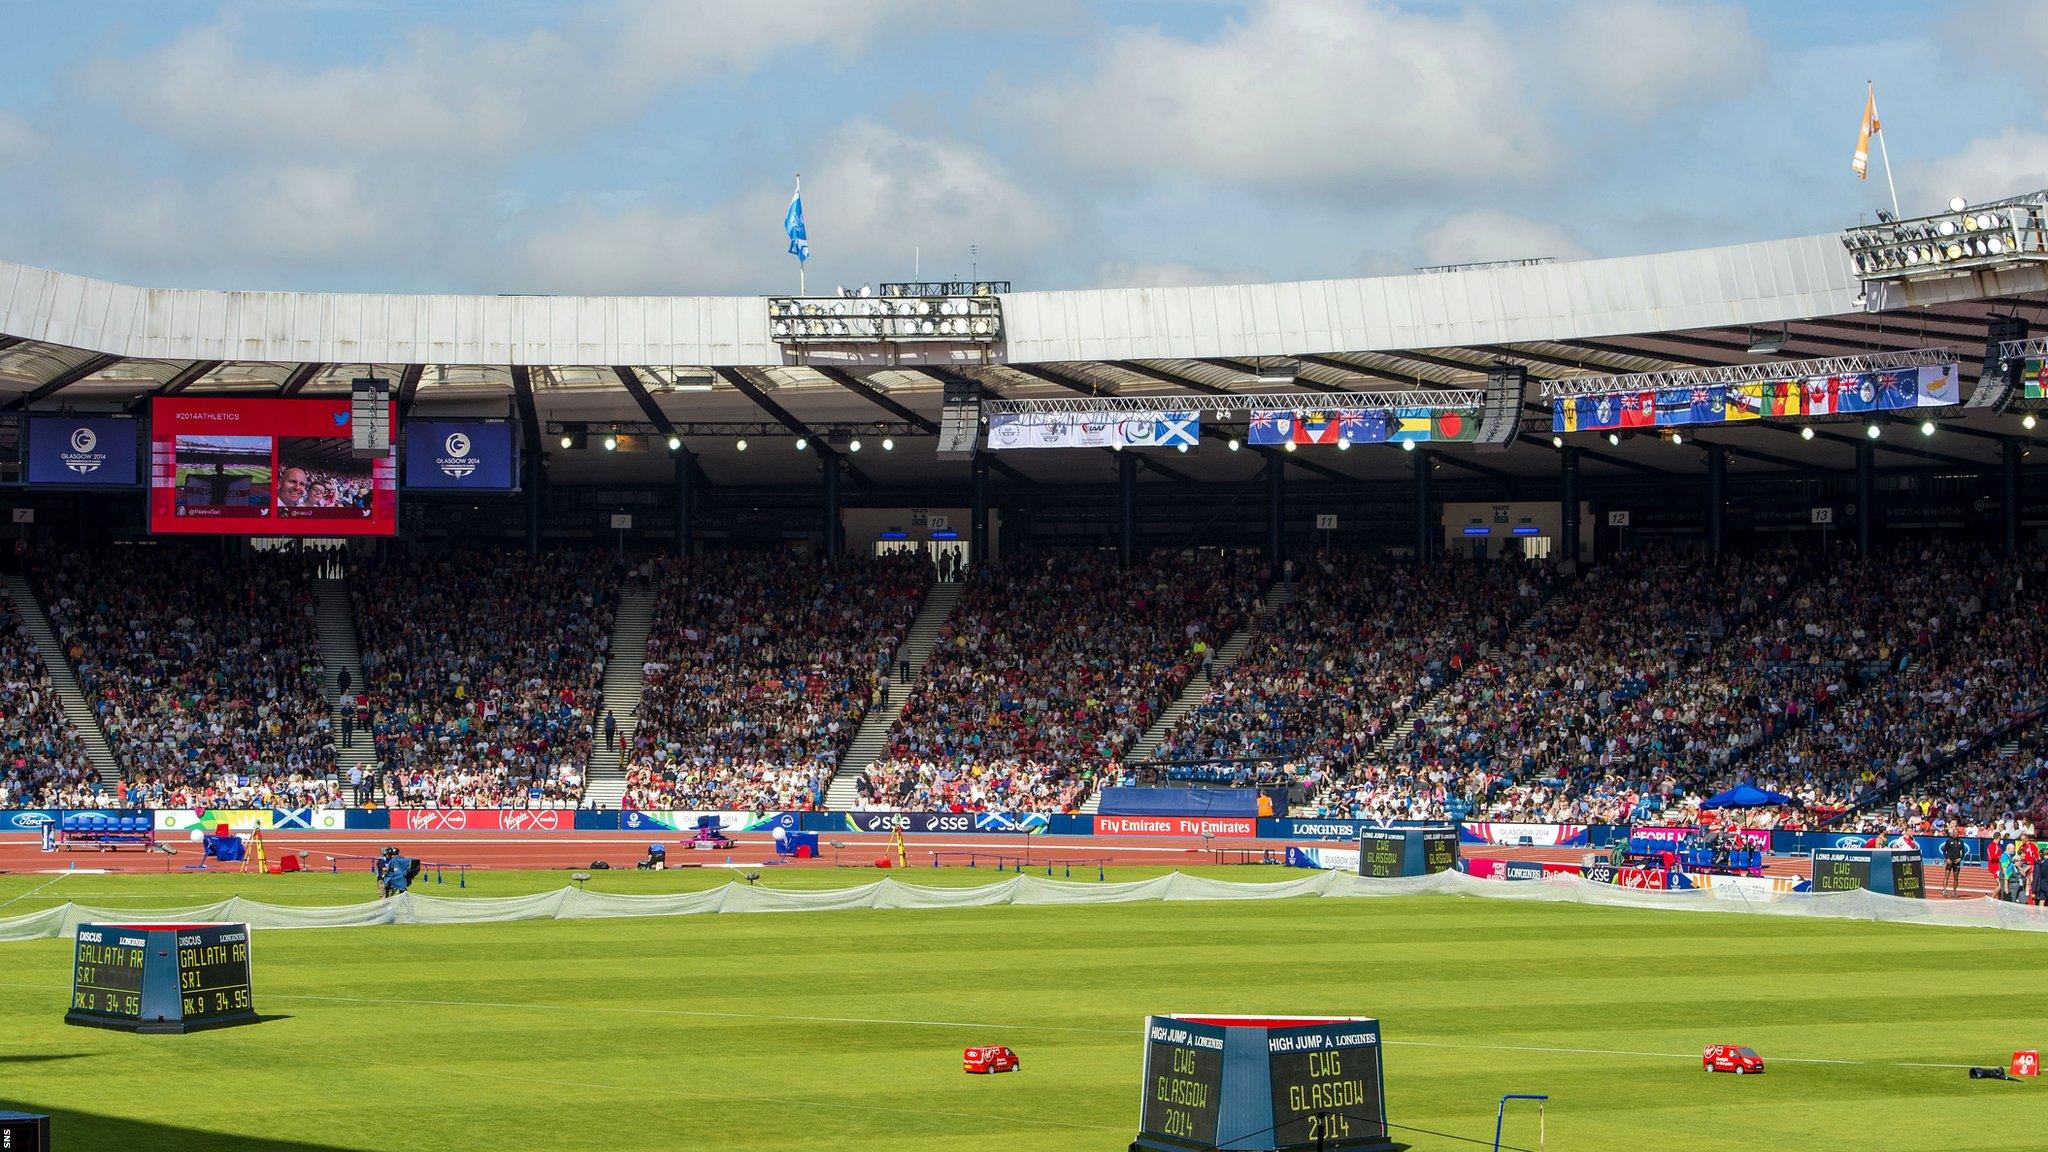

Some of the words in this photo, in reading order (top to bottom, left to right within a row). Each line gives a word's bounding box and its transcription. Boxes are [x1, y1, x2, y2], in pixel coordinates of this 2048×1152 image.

[932, 517, 944, 527] 10
[1320, 516, 1332, 526] 11
[1612, 513, 1625, 523] 12
[1816, 510, 1828, 520] 13
[20, 814, 44, 825] Ford
[412, 810, 437, 829] Virgin
[504, 810, 529, 829] Virgin
[940, 816, 968, 830] sse
[1101, 820, 1119, 833] Fly
[1122, 820, 1171, 832] Emirates
[1180, 821, 1199, 834] Fly
[1202, 821, 1250, 833] Emirates
[1293, 824, 1353, 835] LONGINES
[1376, 840, 1389, 851] CWG
[1367, 852, 1396, 864] GLASGOW
[1373, 865, 1389, 876] 2014
[1508, 868, 1540, 878] LONGINES
[1594, 868, 1609, 880] sse
[1834, 863, 1850, 875] CWG
[1823, 877, 1861, 889] GLASGOW
[80, 932, 102, 942] DISCUS
[119, 937, 146, 947] LONGINES
[179, 936, 201, 947] DISCUS
[220, 933, 245, 942] LONGINES
[79, 944, 123, 967] GALLATH
[130, 950, 144, 968] AR
[180, 945, 228, 968] GALLATH
[233, 944, 246, 962] AR
[78, 966, 96, 984] SRI
[182, 971, 201, 989] SRI
[76, 993, 95, 1009] RK.9
[106, 994, 139, 1015] 34.95
[184, 998, 204, 1015] RK.9
[216, 990, 248, 1010] 34.95
[1152, 1026, 1167, 1040] HIGH
[1167, 1029, 1187, 1043] JUMP
[1187, 1035, 1193, 1046] A
[1195, 1035, 1223, 1050] LONGINES
[1269, 1037, 1294, 1052] HIGH
[1295, 1035, 1322, 1049] JUMP
[1325, 1036, 1333, 1048] A
[1336, 1033, 1376, 1046] LONGINES
[1173, 1048, 1195, 1075] CWG
[1309, 1051, 1341, 1078] CWG
[2018, 1055, 2034, 1065] 40
[1158, 1076, 1208, 1109] GLASGOW
[1290, 1080, 1364, 1111] GLASGOW
[1164, 1109, 1192, 1138] 2014
